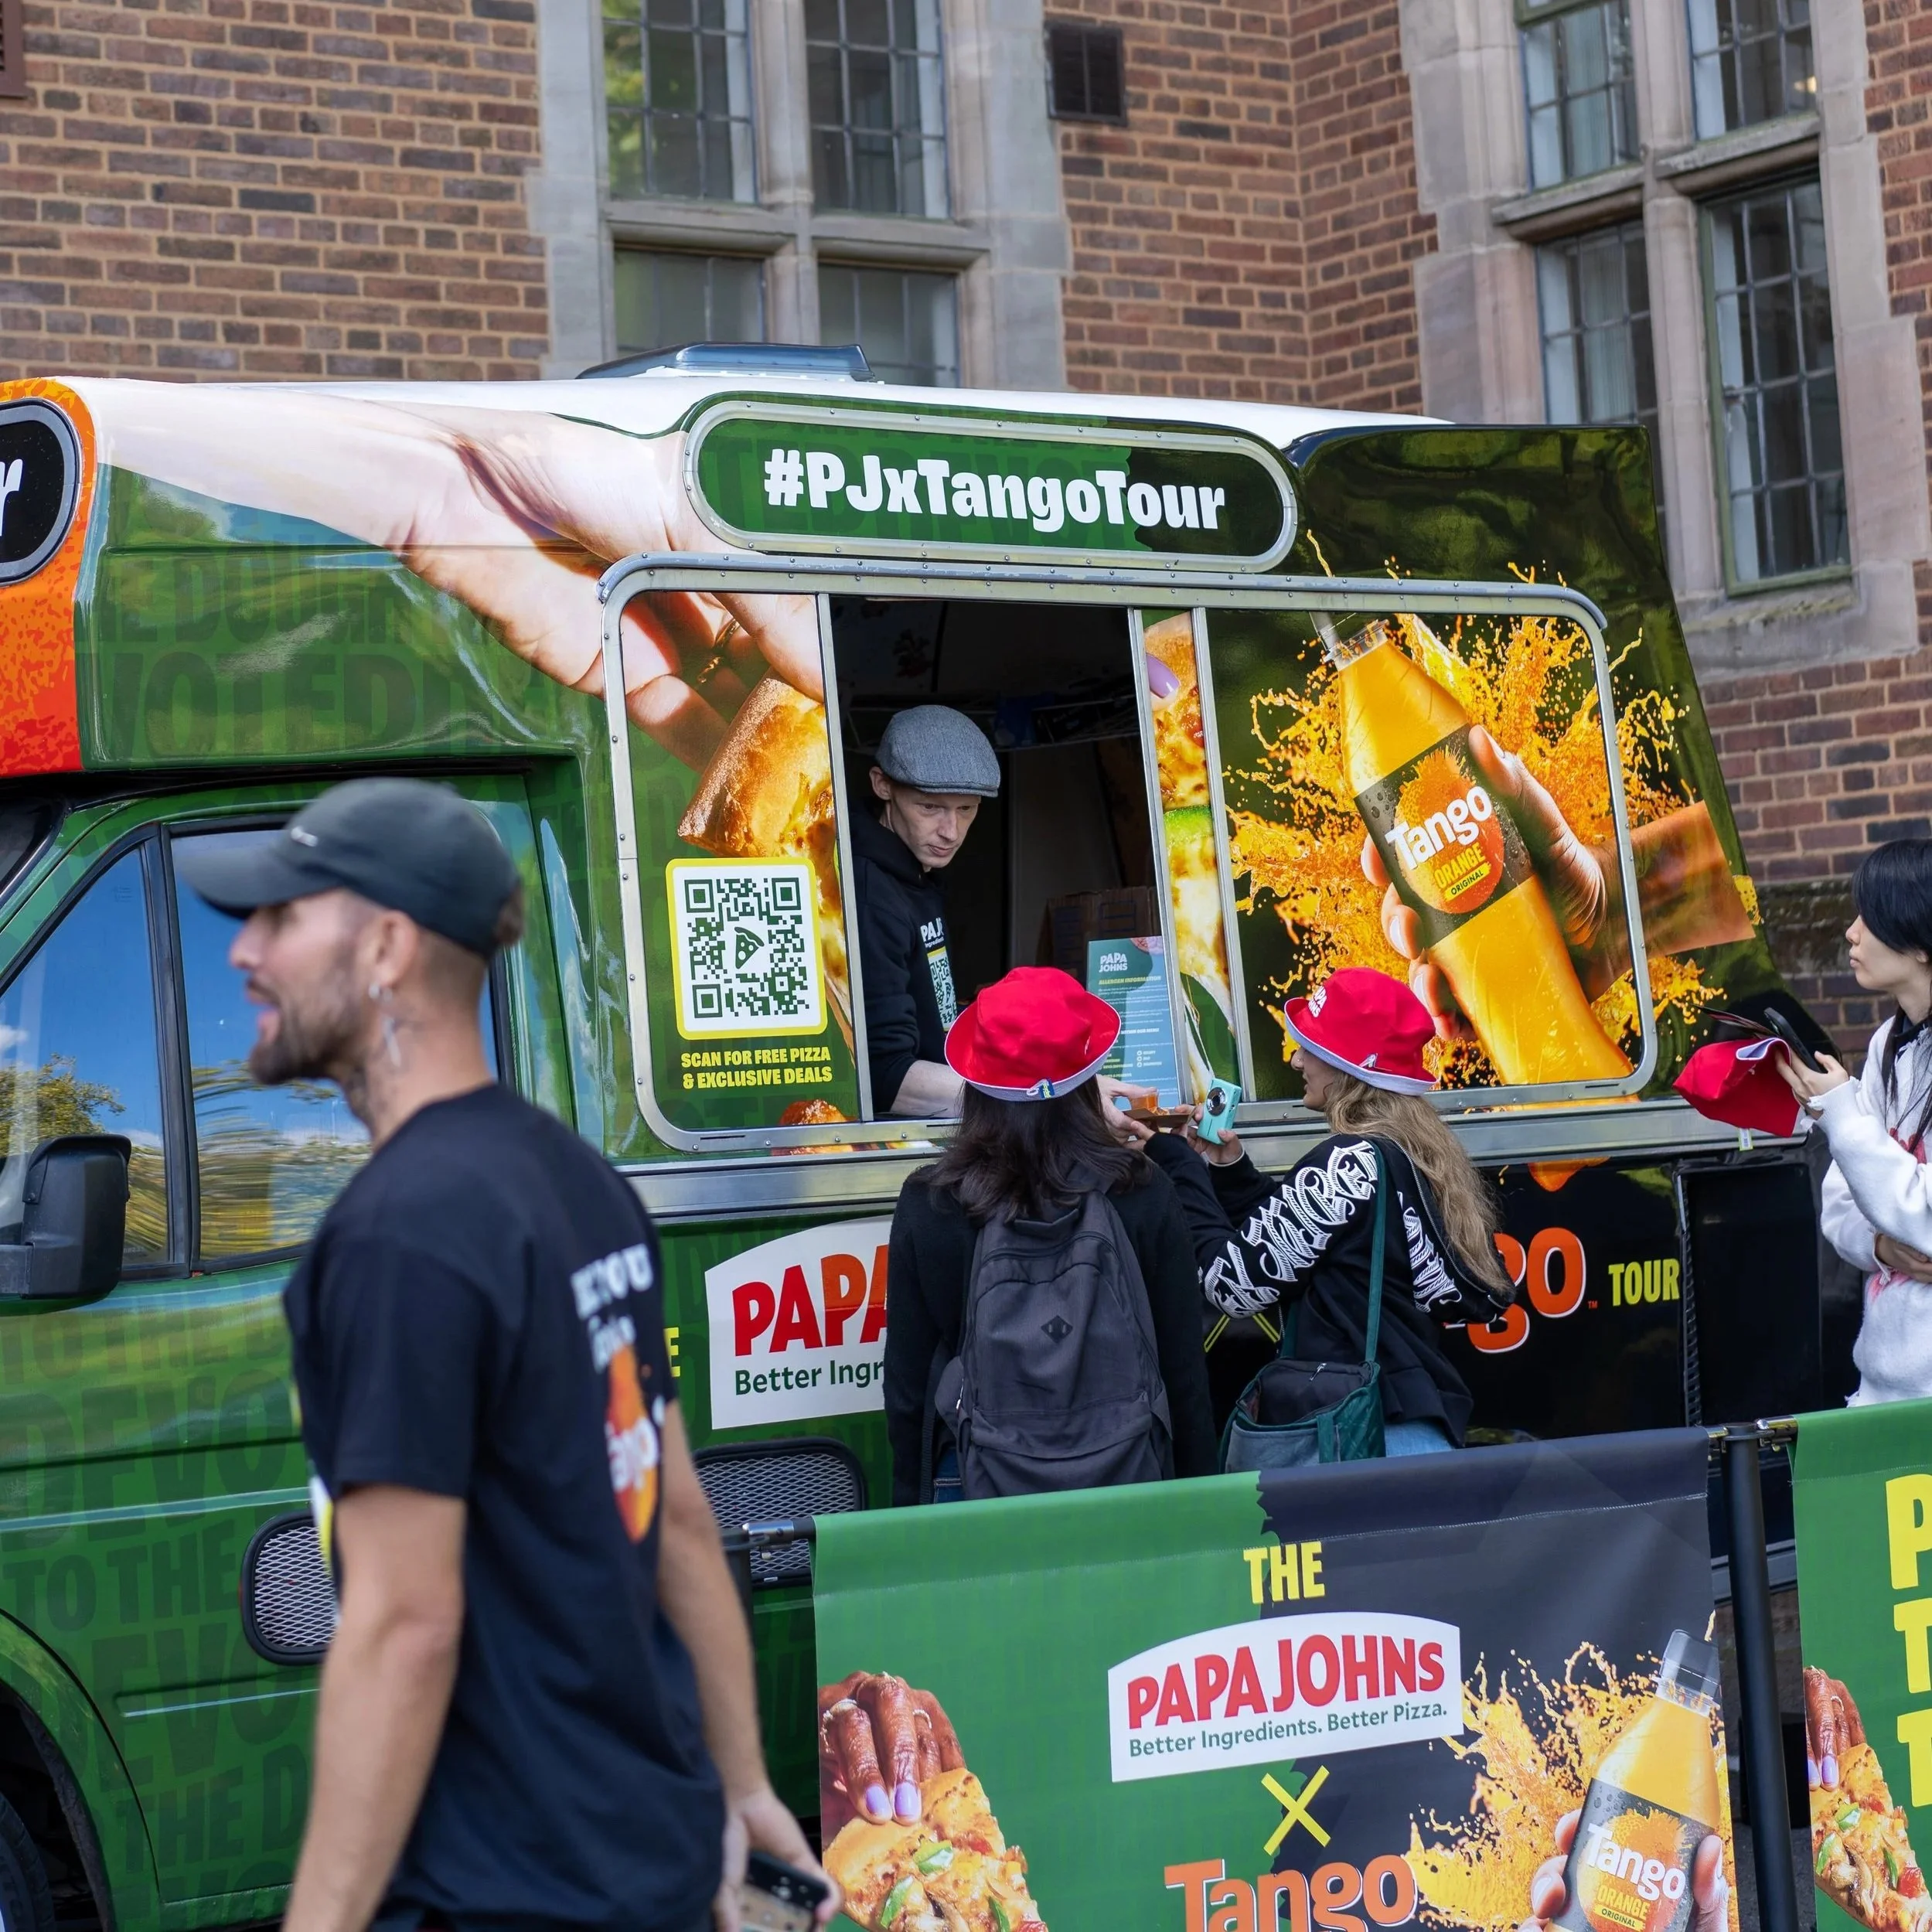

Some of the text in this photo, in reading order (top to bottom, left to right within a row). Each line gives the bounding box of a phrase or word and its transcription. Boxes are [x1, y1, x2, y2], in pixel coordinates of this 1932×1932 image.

[763, 448, 1225, 533] #PJxTangoTour
[1385, 786, 1493, 871] Tango
[1434, 843, 1486, 888] ORANGE
[1451, 871, 1484, 895] ORIGINAL
[1099, 963, 1128, 973] JOHNS
[1100, 952, 1127, 964] PAPA
[681, 1047, 831, 1068] SCAN FOR FREE PIZZA
[683, 1066, 833, 1089] & EXCLUSIVE DEALS
[1608, 1259, 1680, 1307] TOUR
[735, 1366, 822, 1395] Better
[1243, 1541, 1325, 1604] THE
[1127, 1634, 1444, 1729] PAPA JOHNS
[1130, 1702, 1447, 1757] Better Ingredients. Better Pizza.
[1587, 1823, 1686, 1901] Tango
[1164, 1855, 1418, 1932] Tango
[1596, 1884, 1651, 1920] ORANGE
[1601, 1908, 1635, 1928] ORIGINAL
